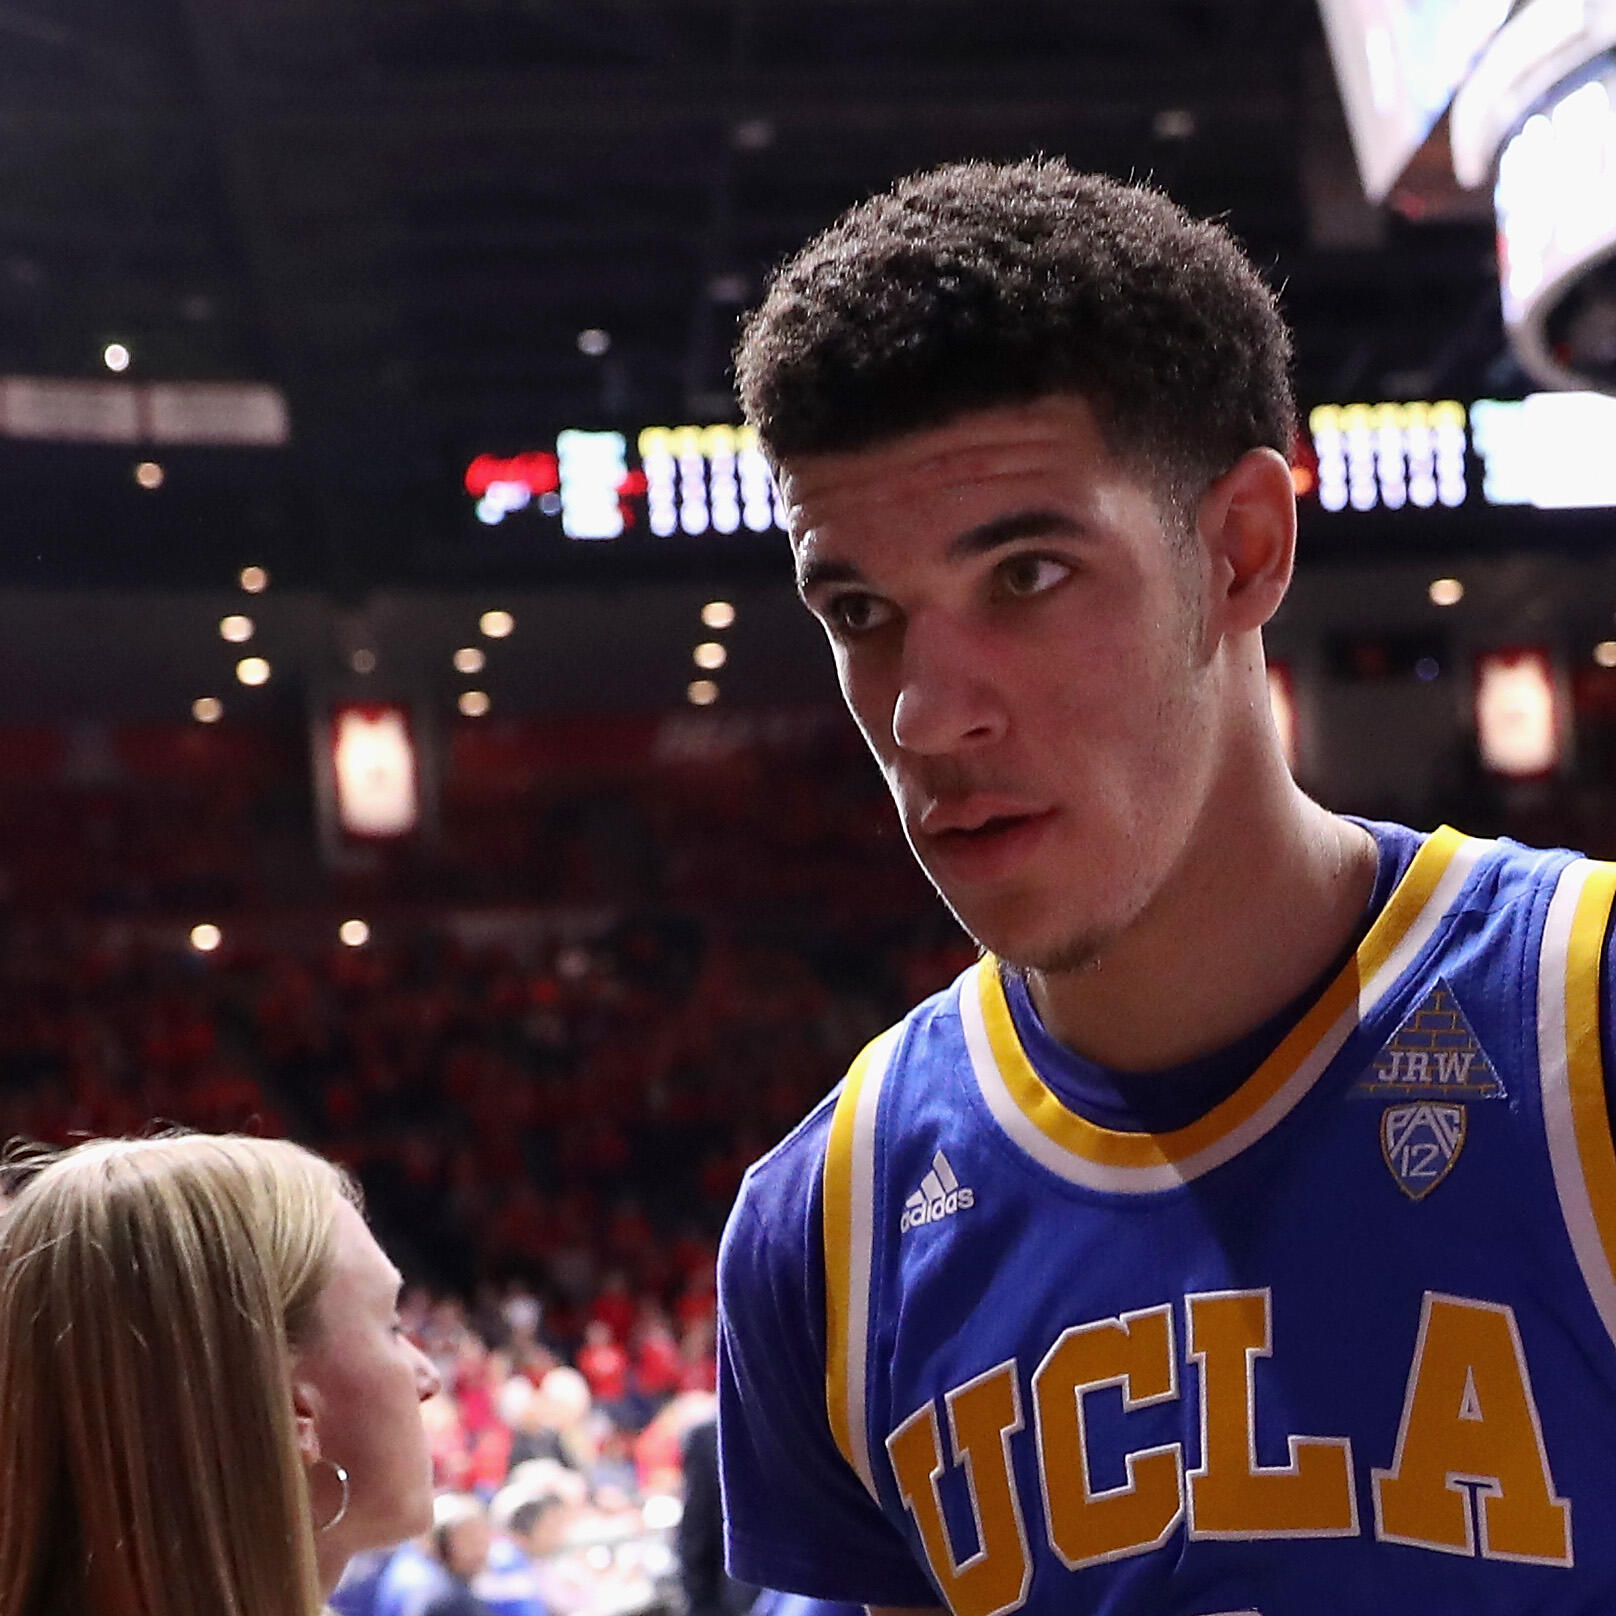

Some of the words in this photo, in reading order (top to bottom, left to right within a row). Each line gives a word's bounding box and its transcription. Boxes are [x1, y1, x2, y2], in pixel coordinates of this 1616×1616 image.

[1378, 1052, 1475, 1083] JRW
[1386, 1106, 1461, 1159] PAC
[1401, 1143, 1440, 1177] 12
[900, 1188, 974, 1234] adidas
